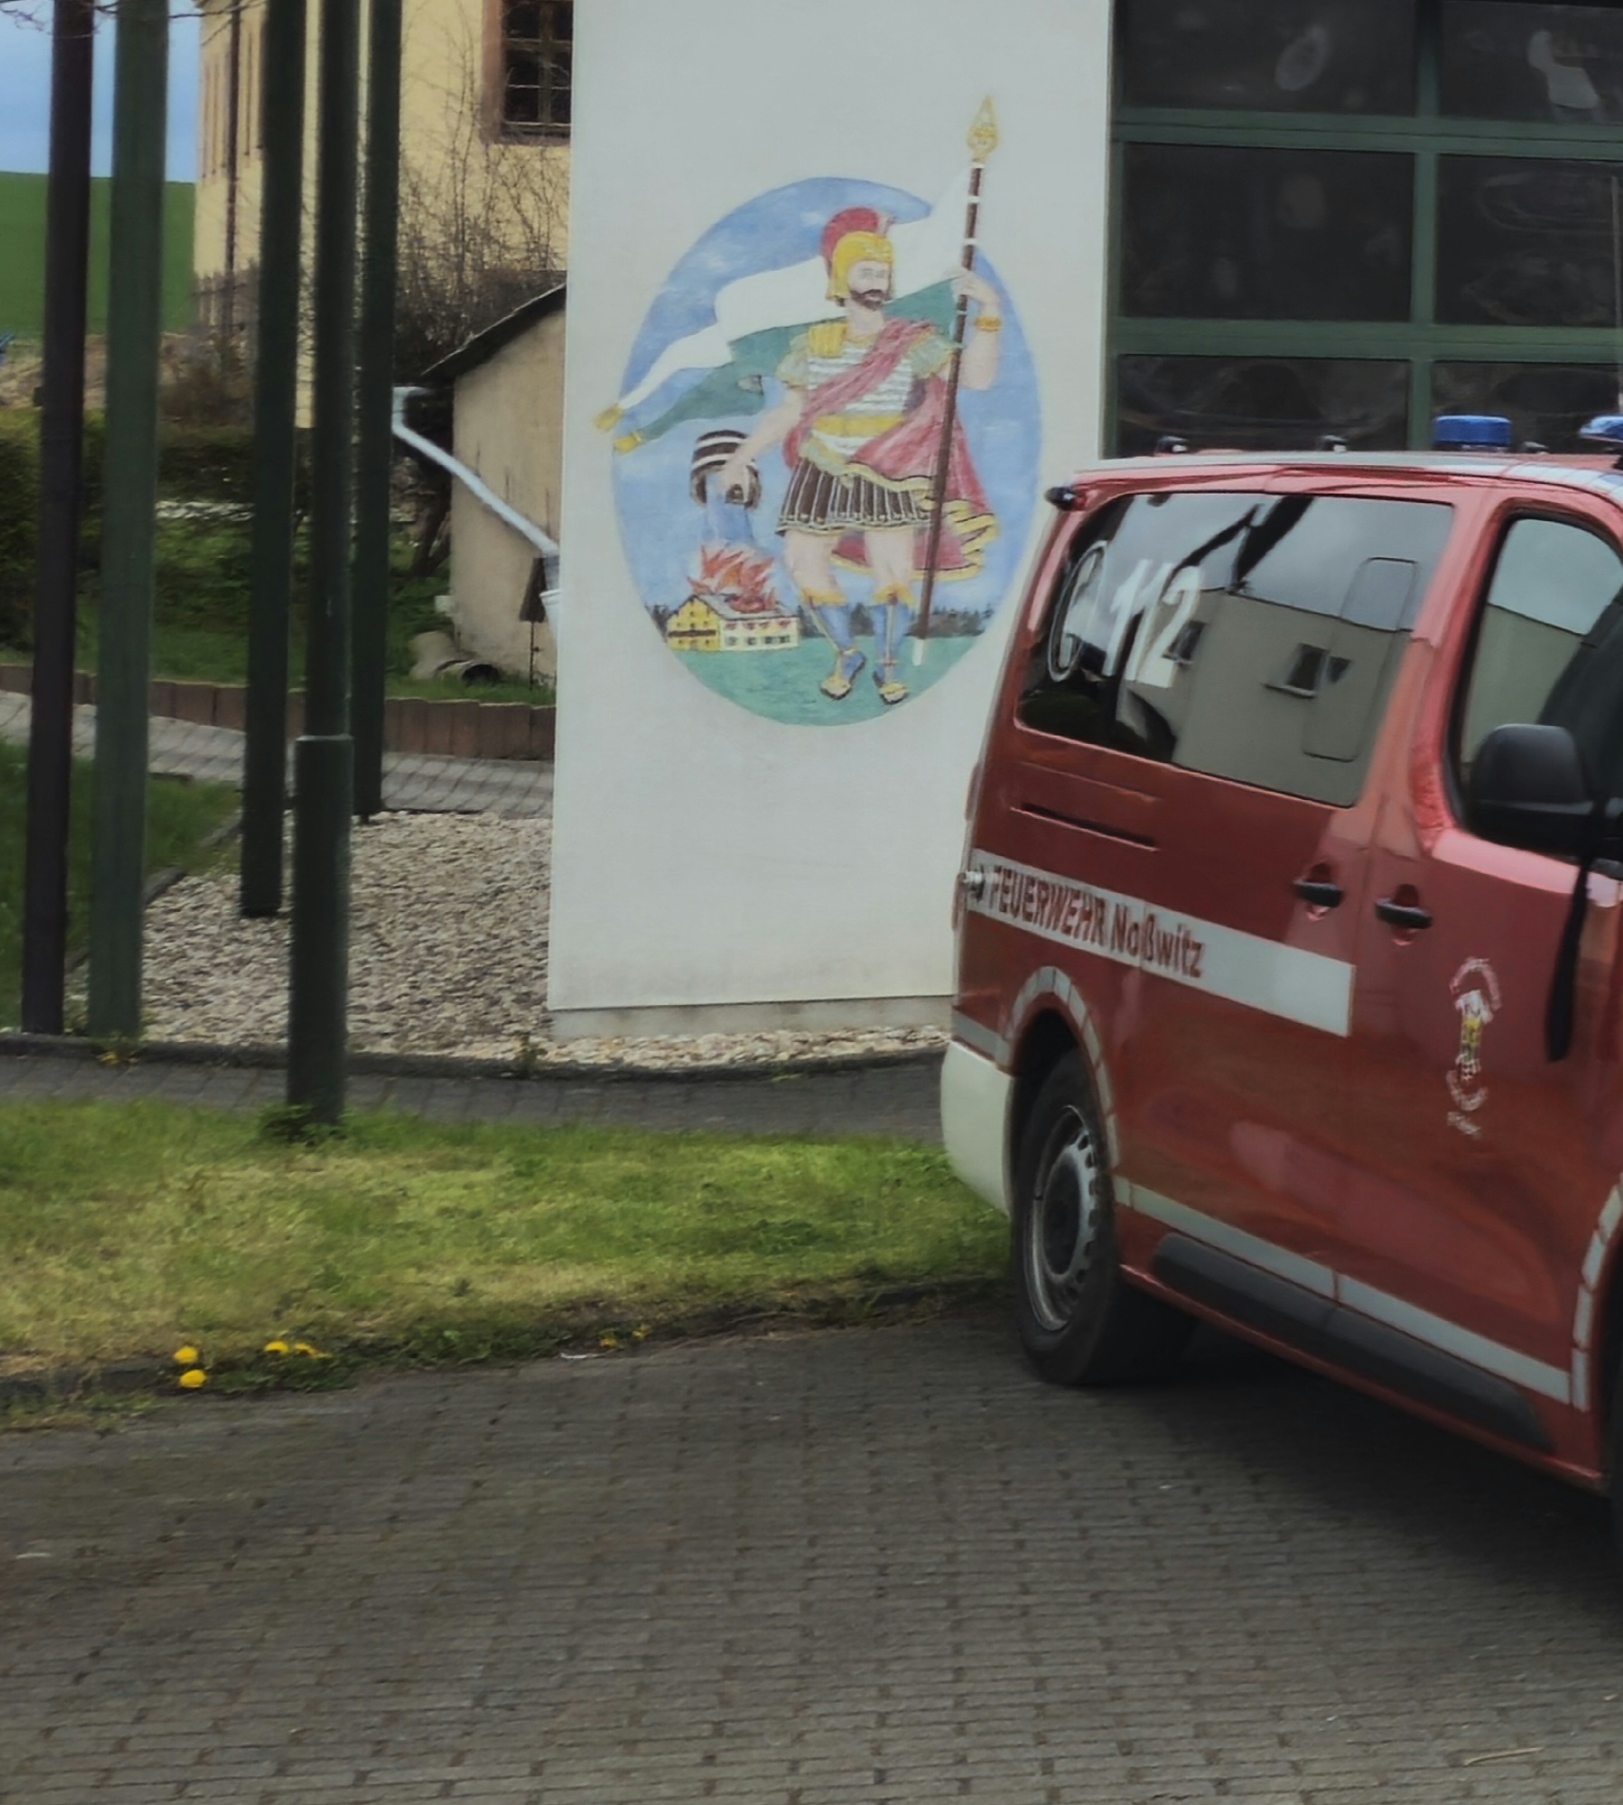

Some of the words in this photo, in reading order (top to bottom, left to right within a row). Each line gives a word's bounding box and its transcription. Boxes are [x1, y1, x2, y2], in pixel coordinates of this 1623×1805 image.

[1102, 558, 1200, 688] 112
[990, 864, 1107, 947] FEUERWEHR
[1110, 902, 1205, 978] Noßwitz
